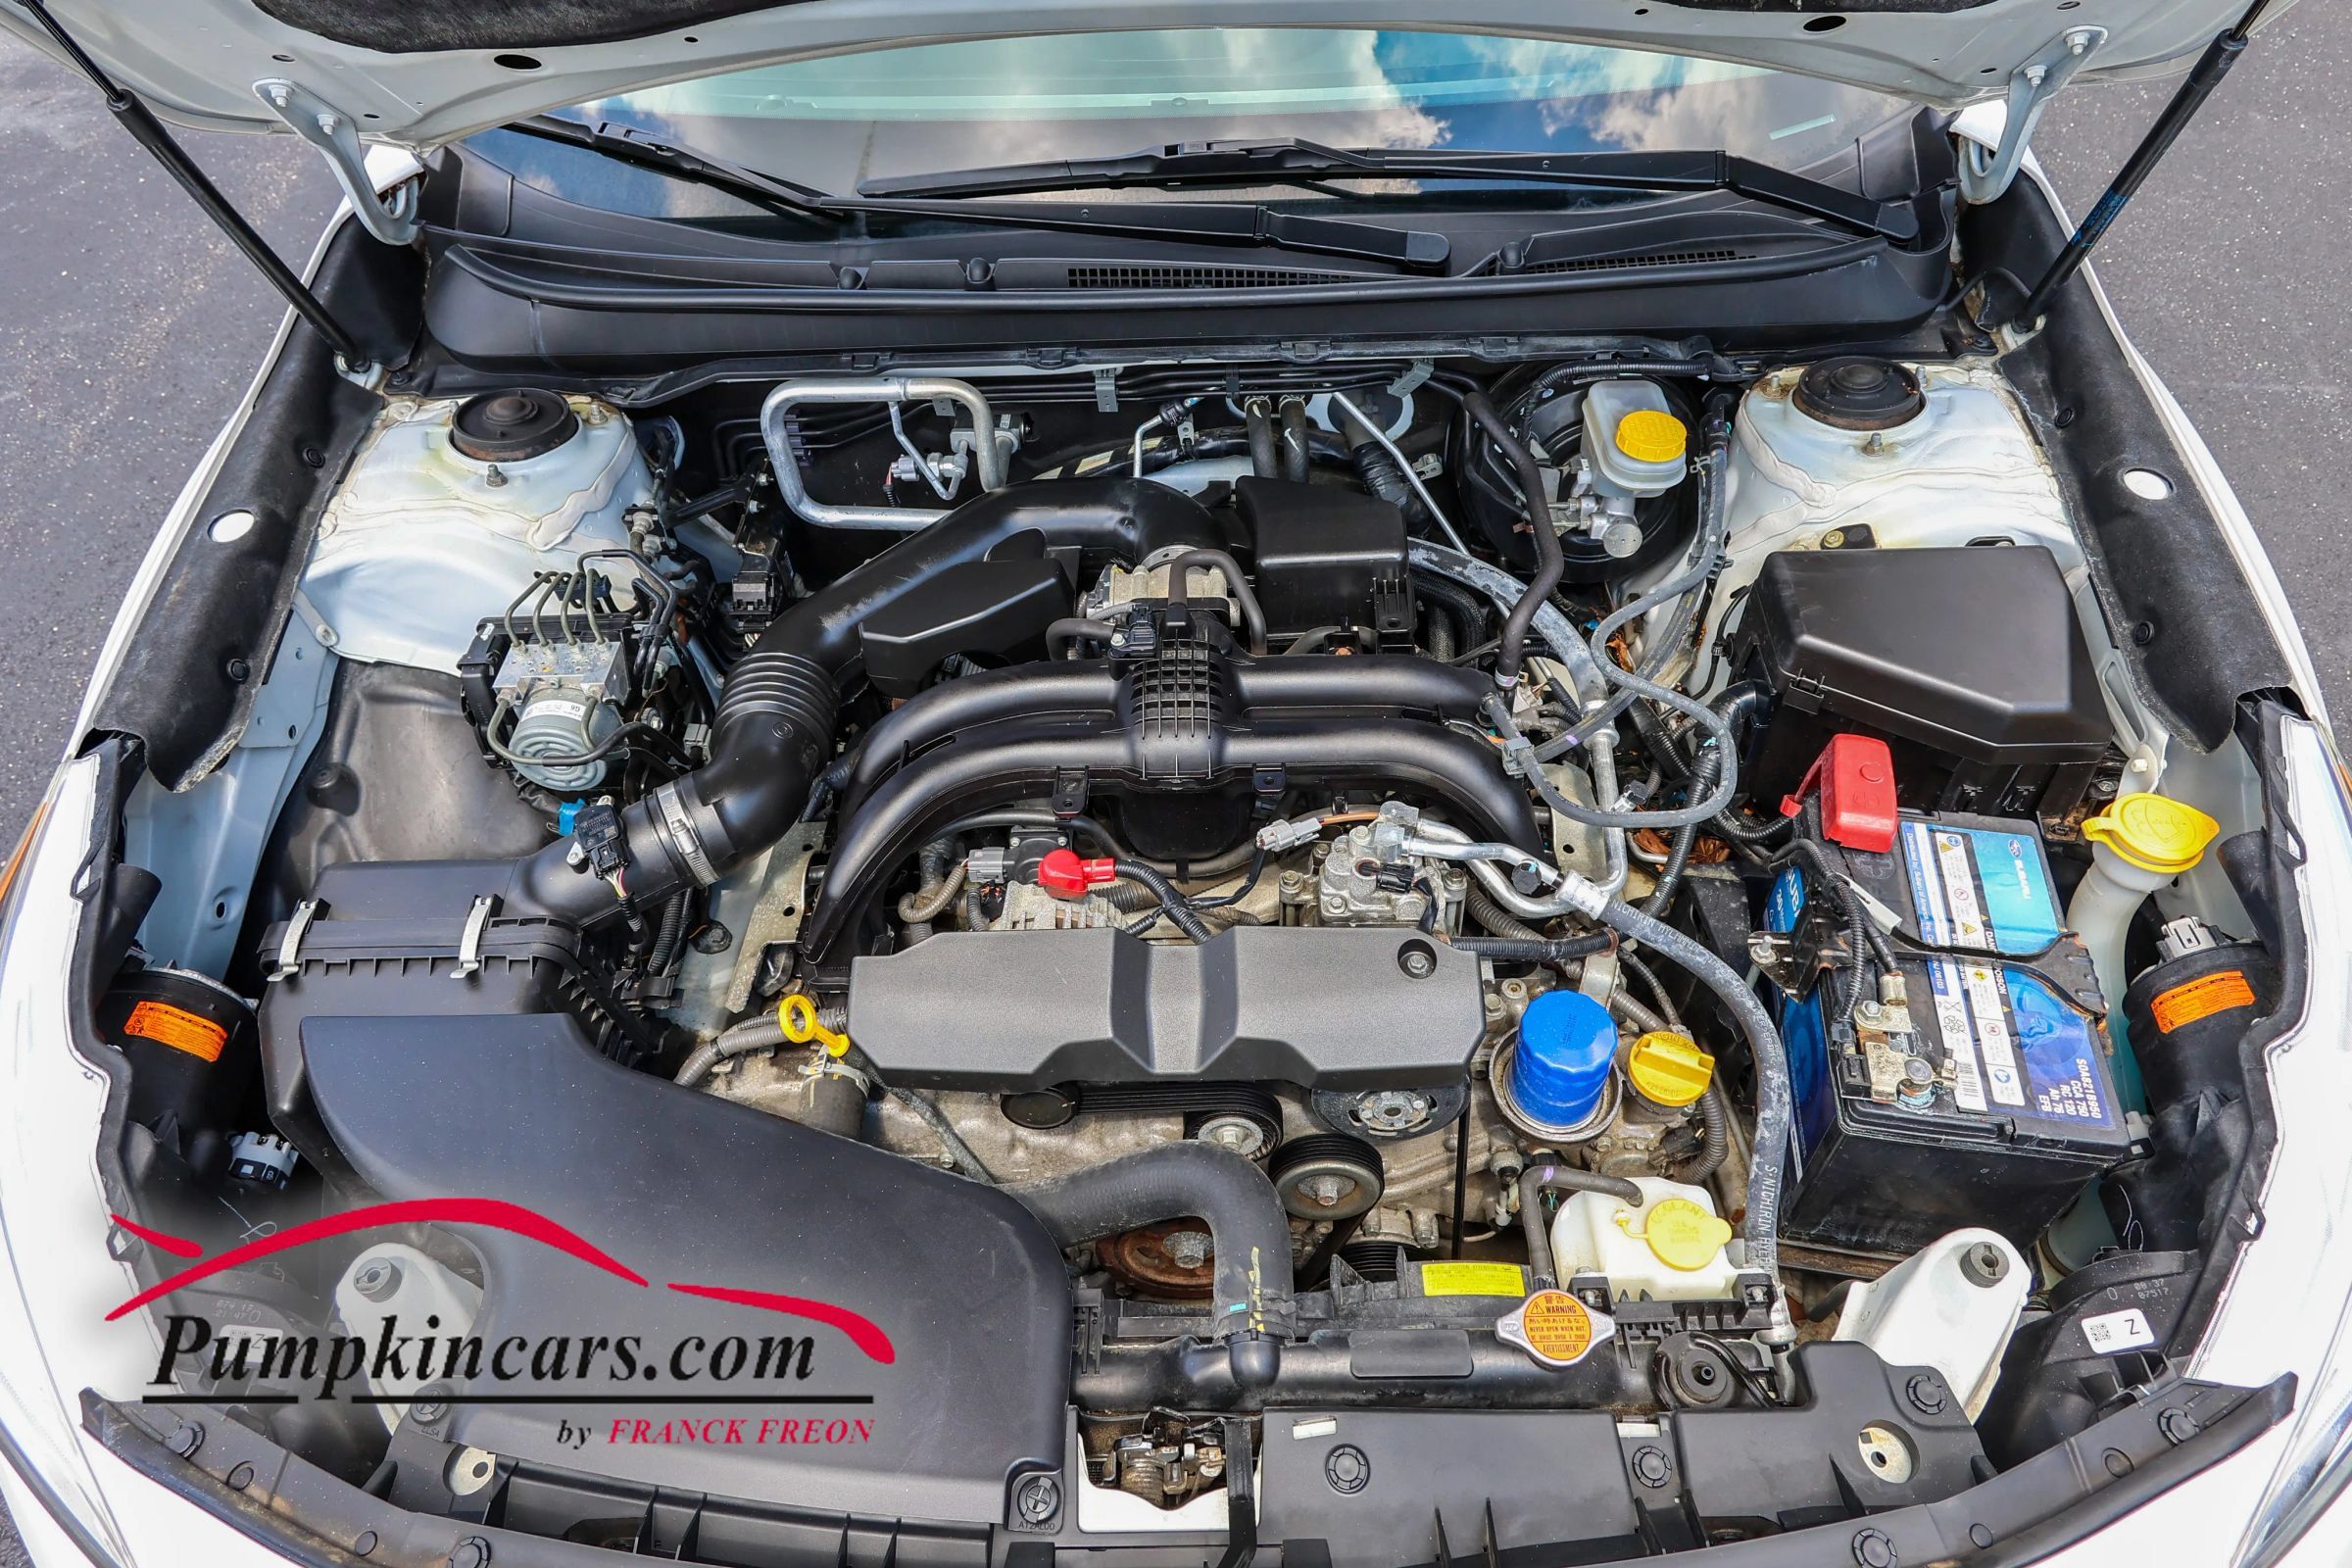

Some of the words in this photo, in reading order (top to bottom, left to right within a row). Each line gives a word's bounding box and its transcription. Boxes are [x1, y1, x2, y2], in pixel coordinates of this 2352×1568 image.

[2048, 1088, 2060, 1101] Ah
[2060, 1084, 2070, 1098] RC
[2070, 1080, 2082, 1098] CCA
[2076, 1099, 2089, 1117] 750
[2064, 1099, 2077, 1116] 120
[2125, 1318, 2140, 1335] Z
